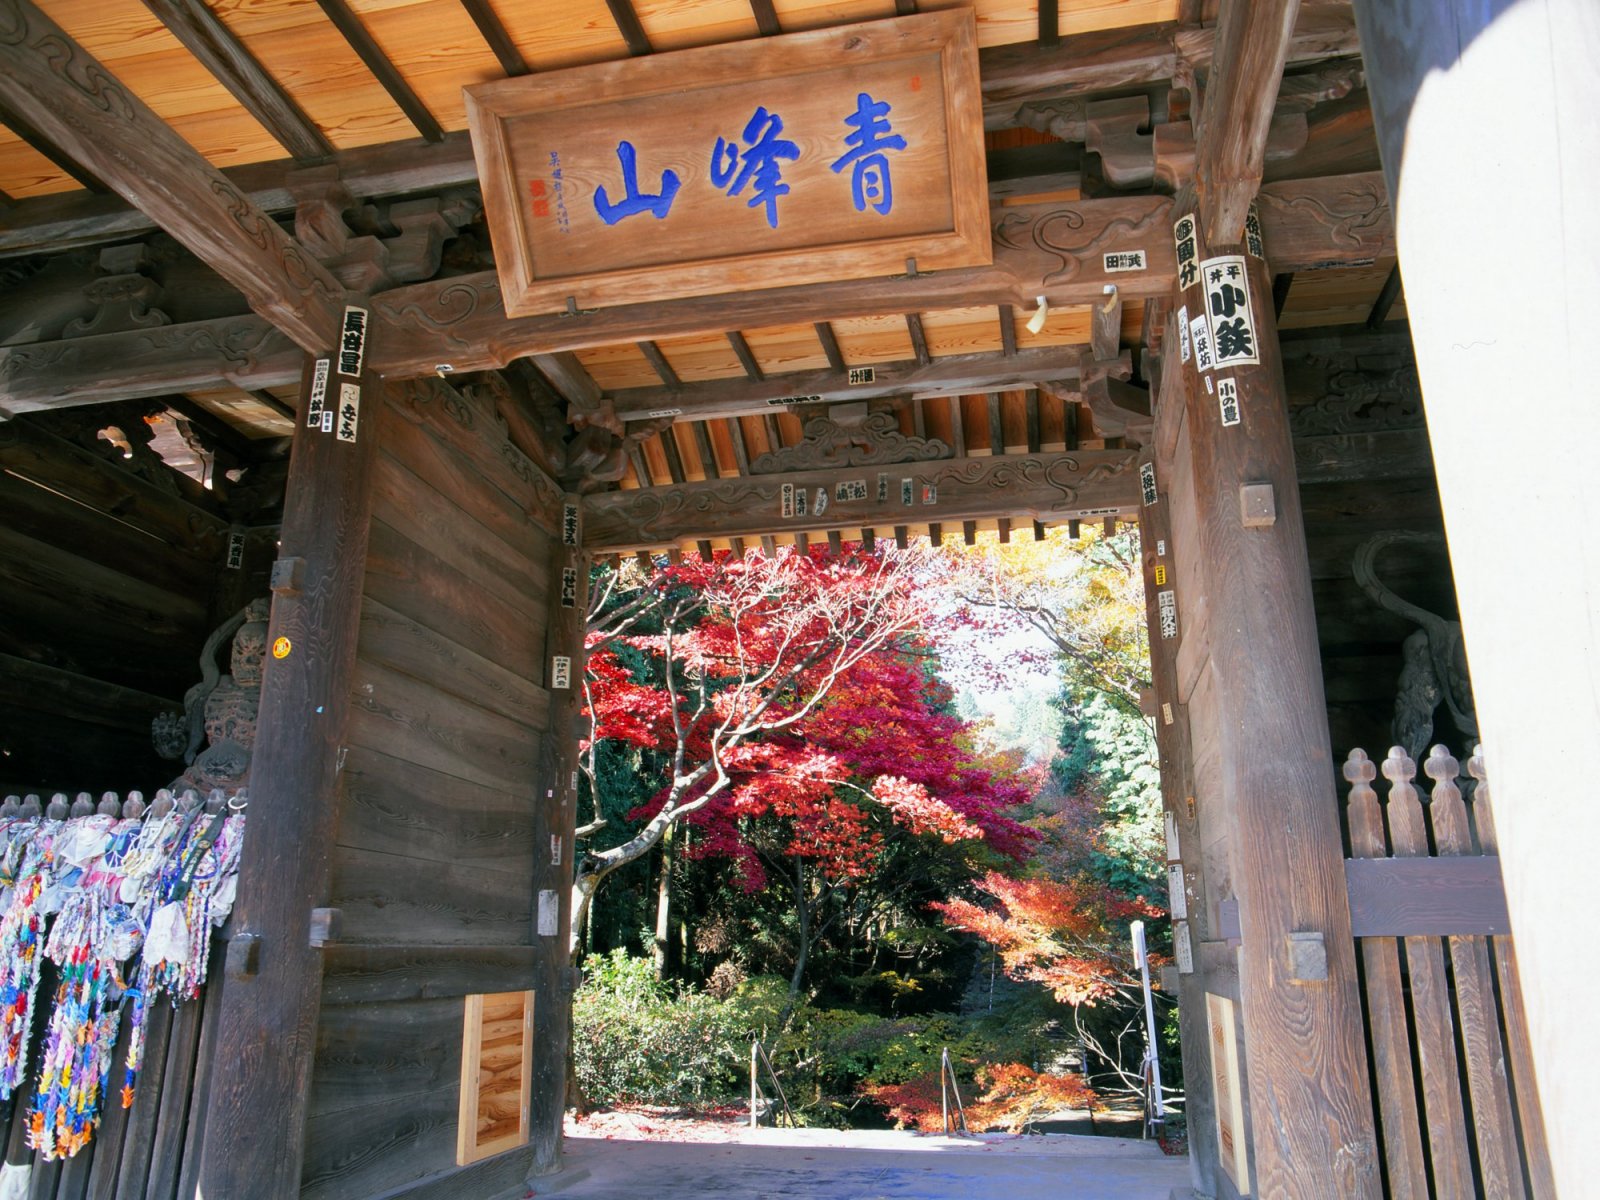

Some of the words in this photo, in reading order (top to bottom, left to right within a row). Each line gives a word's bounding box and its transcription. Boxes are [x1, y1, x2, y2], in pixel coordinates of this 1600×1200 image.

[593, 92, 908, 229] 青峰山
[1210, 283, 1253, 360] 小鉄
[1220, 382, 1238, 424] 小の豊
